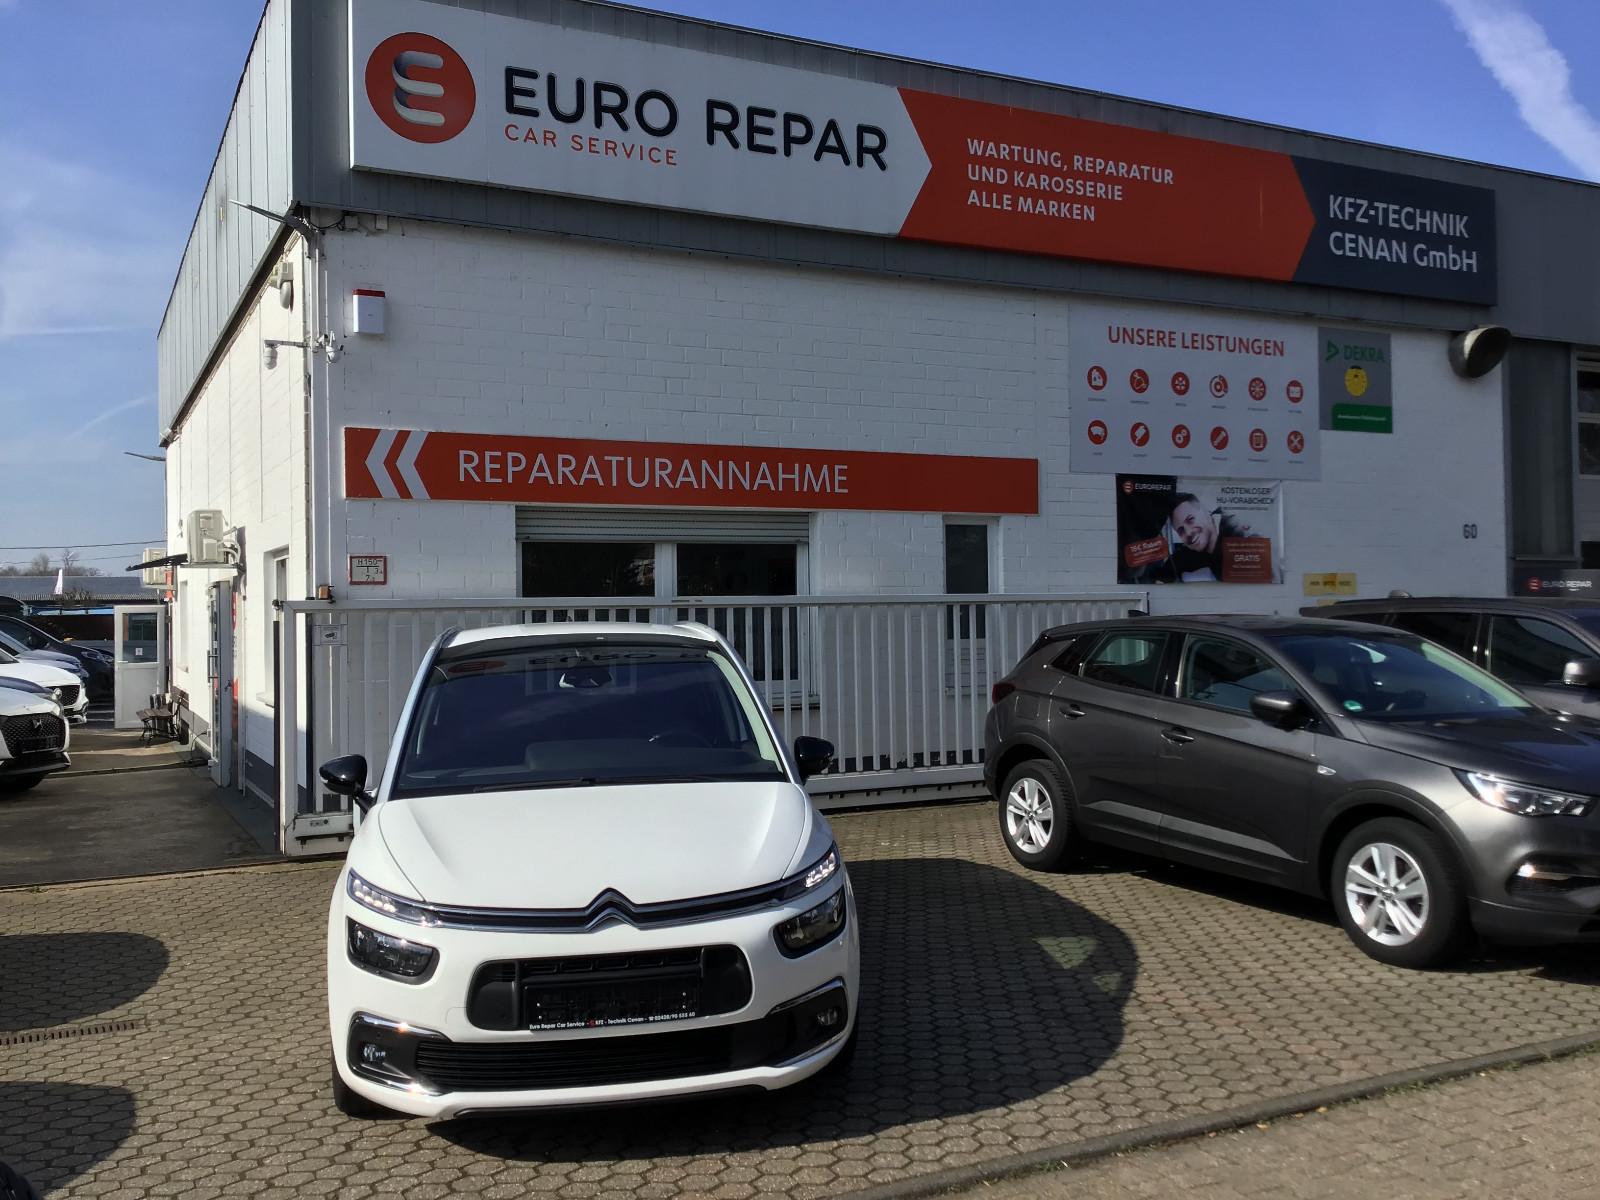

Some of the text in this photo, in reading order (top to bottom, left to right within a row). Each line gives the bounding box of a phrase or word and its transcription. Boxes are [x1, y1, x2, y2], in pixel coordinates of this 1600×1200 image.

[504, 65, 889, 172] EURO REPAR
[503, 123, 679, 167] CAR SERVICE
[967, 137, 1176, 186] WARTUNG, REPARATUR
[967, 163, 1124, 202] UND KAROSSERIE
[967, 189, 1096, 223] ALLE MARKEN
[1328, 193, 1470, 239] KFZ-TECHNIK
[1328, 230, 1479, 274] CENAN GmbH
[1108, 325, 1285, 357] UNSERE LEISTUNGEN
[1343, 344, 1385, 363] DEKRA
[458, 448, 849, 495] REPARATURANNAHME
[1463, 524, 1478, 539] 60
